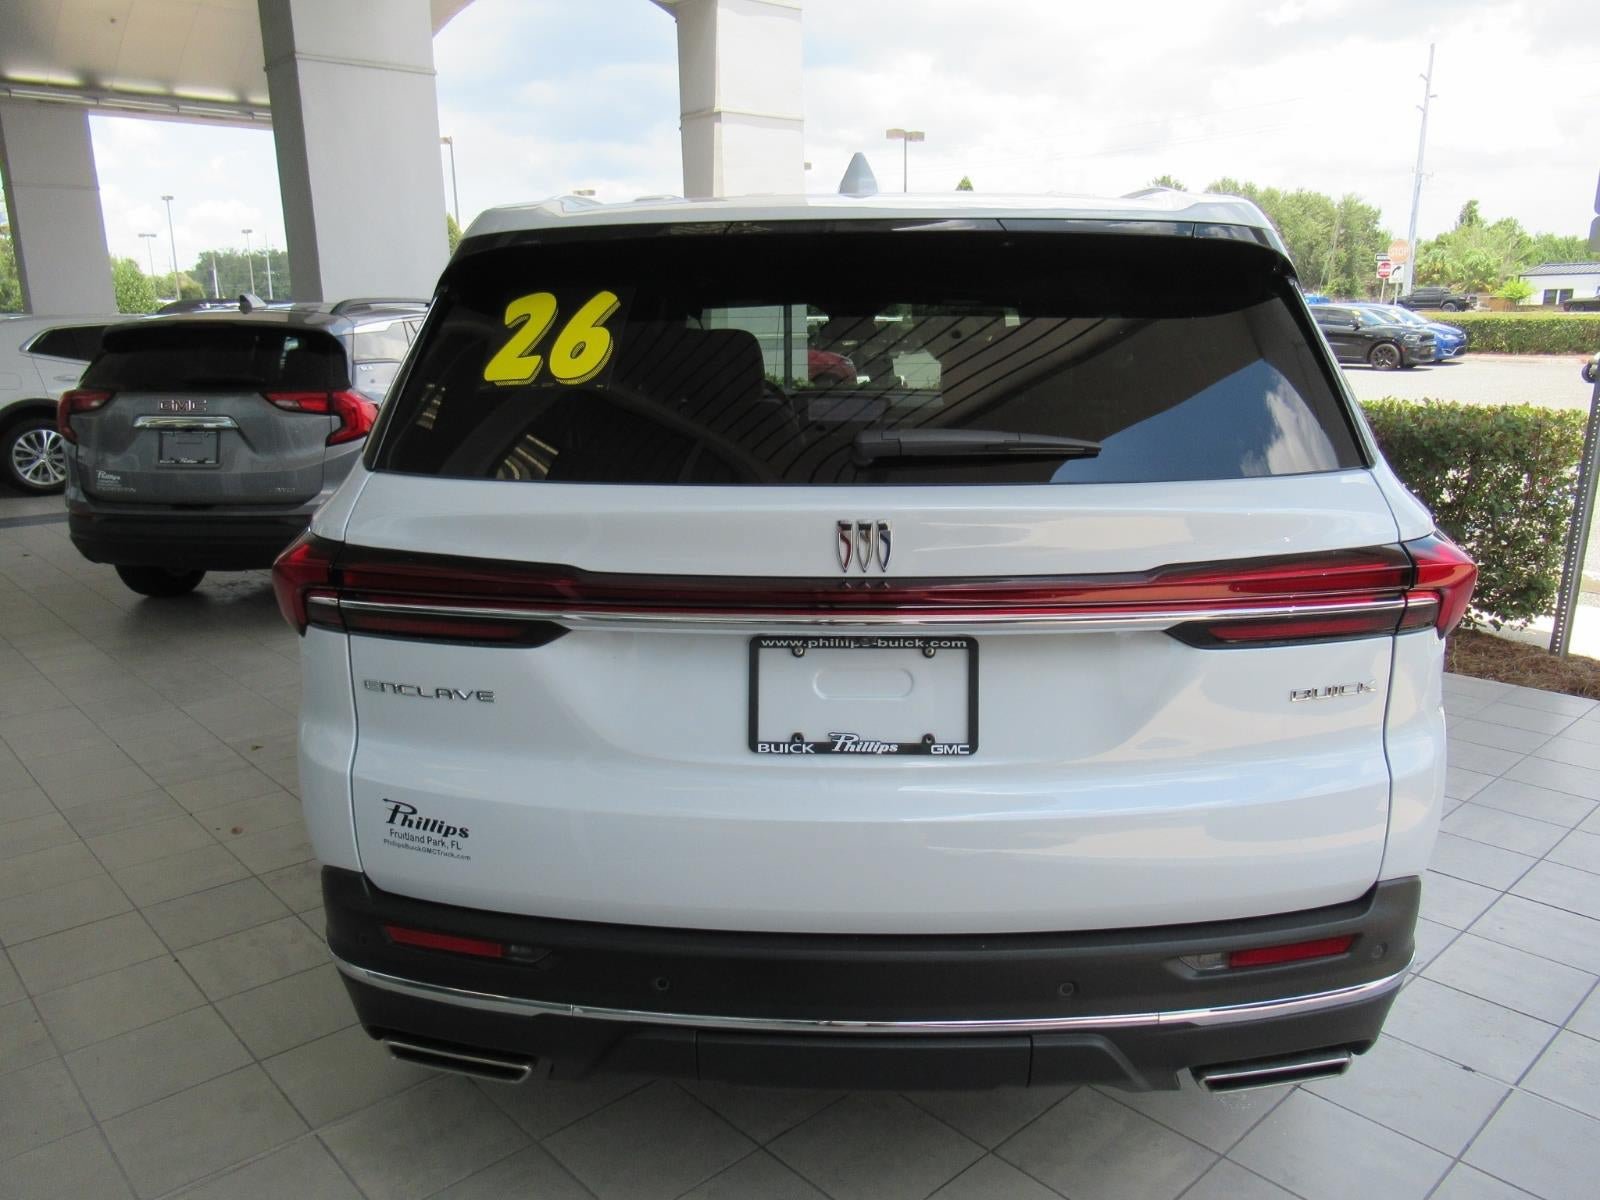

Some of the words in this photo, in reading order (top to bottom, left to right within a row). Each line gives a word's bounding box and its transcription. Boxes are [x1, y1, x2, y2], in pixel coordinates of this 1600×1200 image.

[1389, 247, 1408, 257] STOP
[484, 289, 621, 386] 26
[159, 400, 207, 412] GMC
[364, 679, 495, 703] ENCLAVE
[1290, 679, 1377, 702] BUICK
[757, 743, 815, 754] BUICK
[828, 732, 899, 755] Phillips
[930, 744, 970, 755] GMC
[382, 798, 470, 839] Phillips
[389, 828, 425, 844] Fruitland
[450, 840, 463, 851] FL
